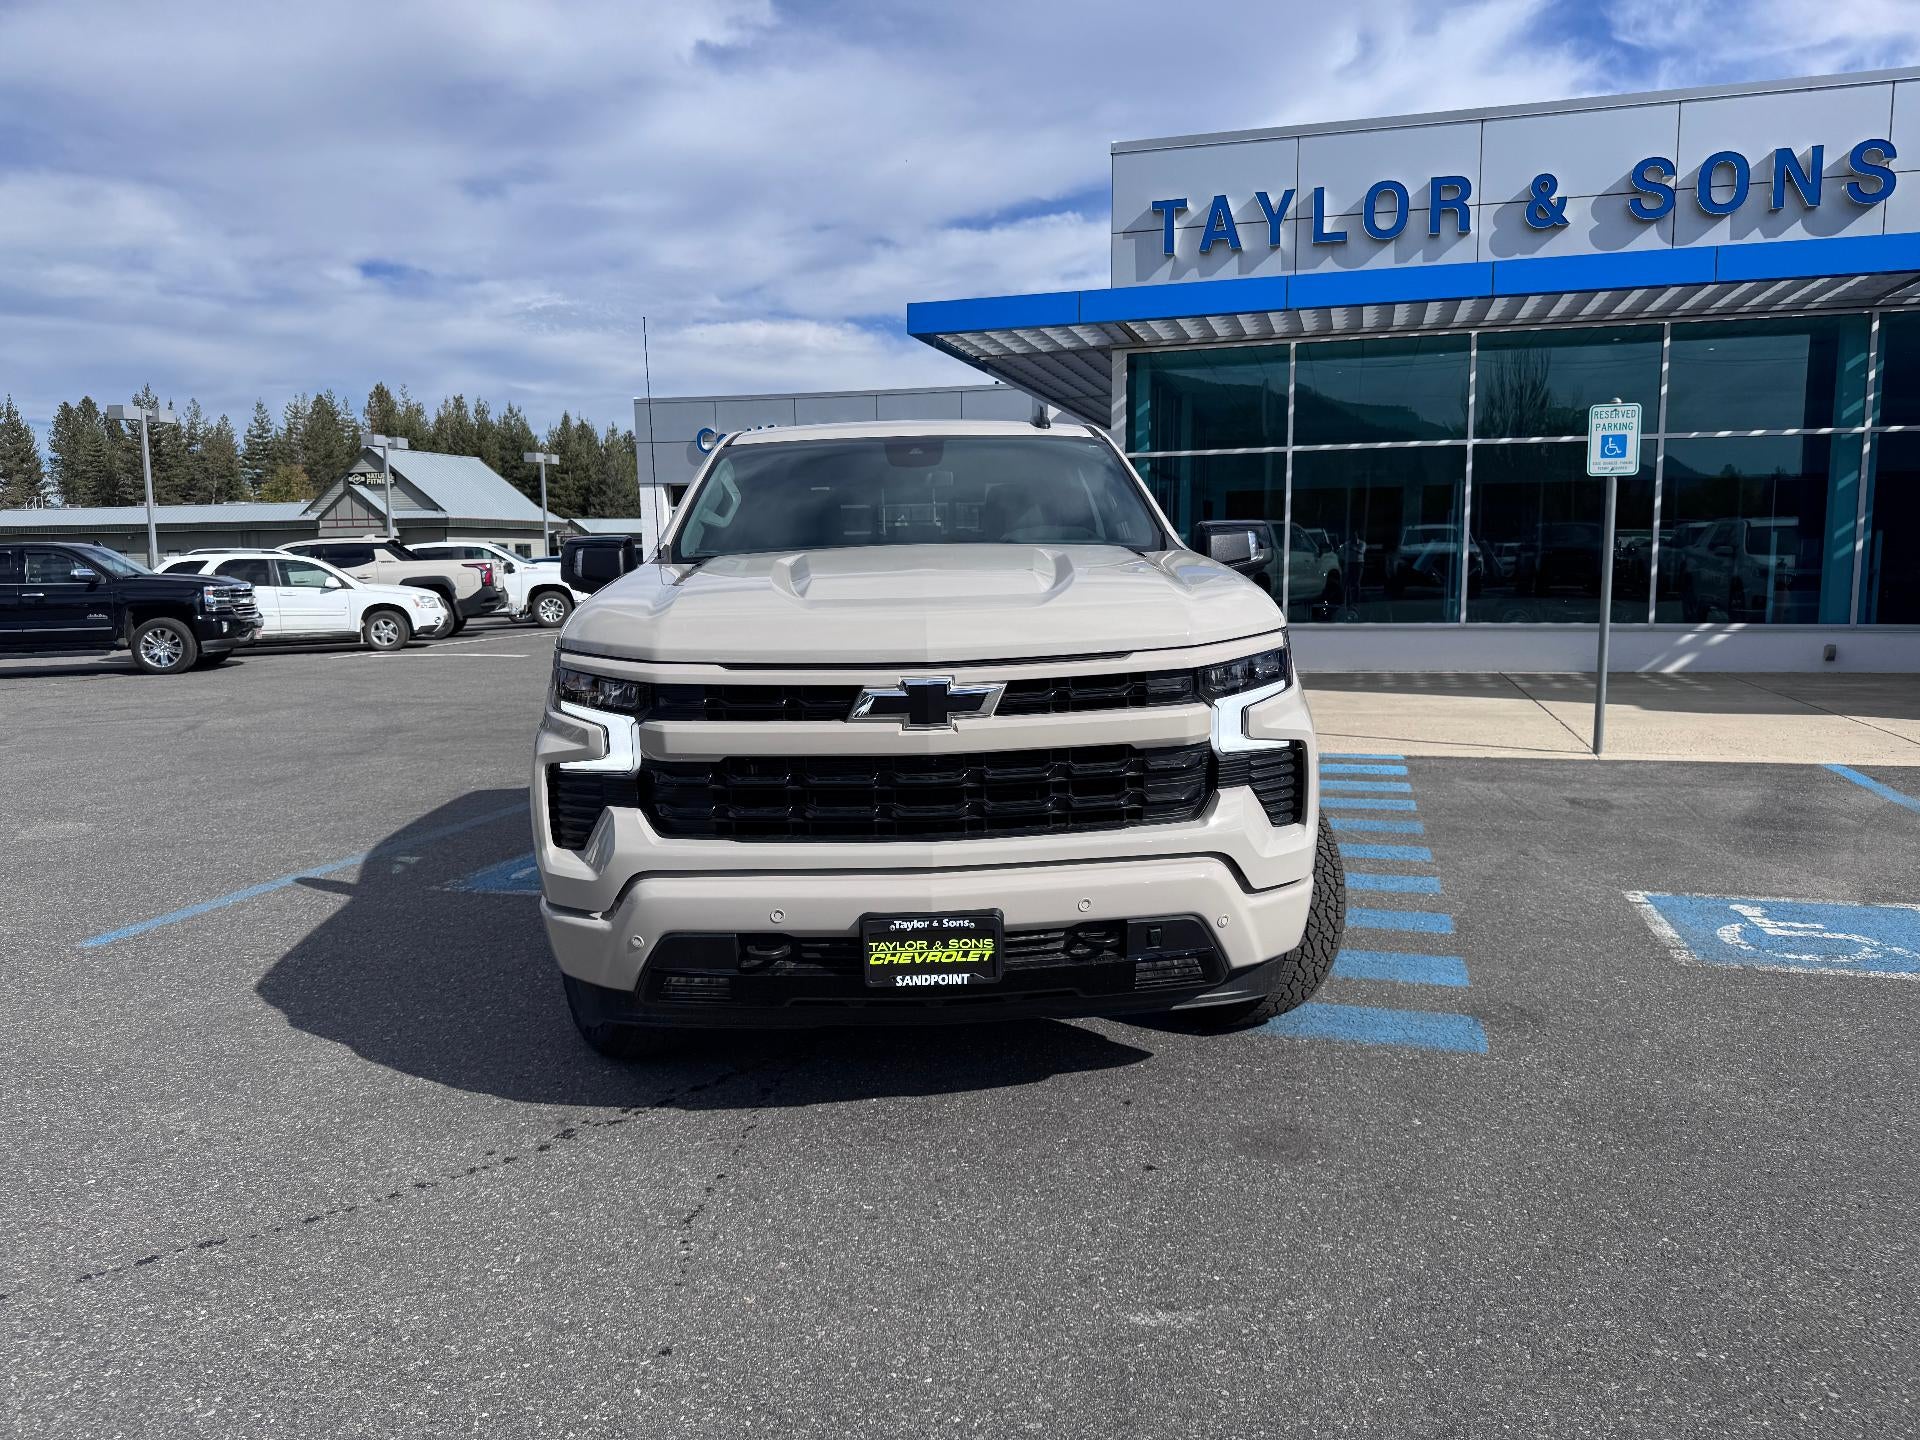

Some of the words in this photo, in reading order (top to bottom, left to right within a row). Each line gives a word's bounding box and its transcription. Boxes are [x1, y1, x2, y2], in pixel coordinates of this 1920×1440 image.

[1152, 174, 1472, 255] TAYLOR
[1525, 173, 1570, 230] &
[1628, 138, 1898, 220] SONS
[1593, 409, 1636, 420] RESERVED
[1595, 422, 1633, 431] PARKING
[894, 919, 929, 931] Taylor
[942, 918, 969, 928] Sons
[868, 940, 928, 952] TAYLOR
[932, 940, 943, 951] &
[948, 938, 995, 949] SONS
[869, 950, 995, 965] CHEVROLET
[895, 973, 970, 987] SANDPOINT
